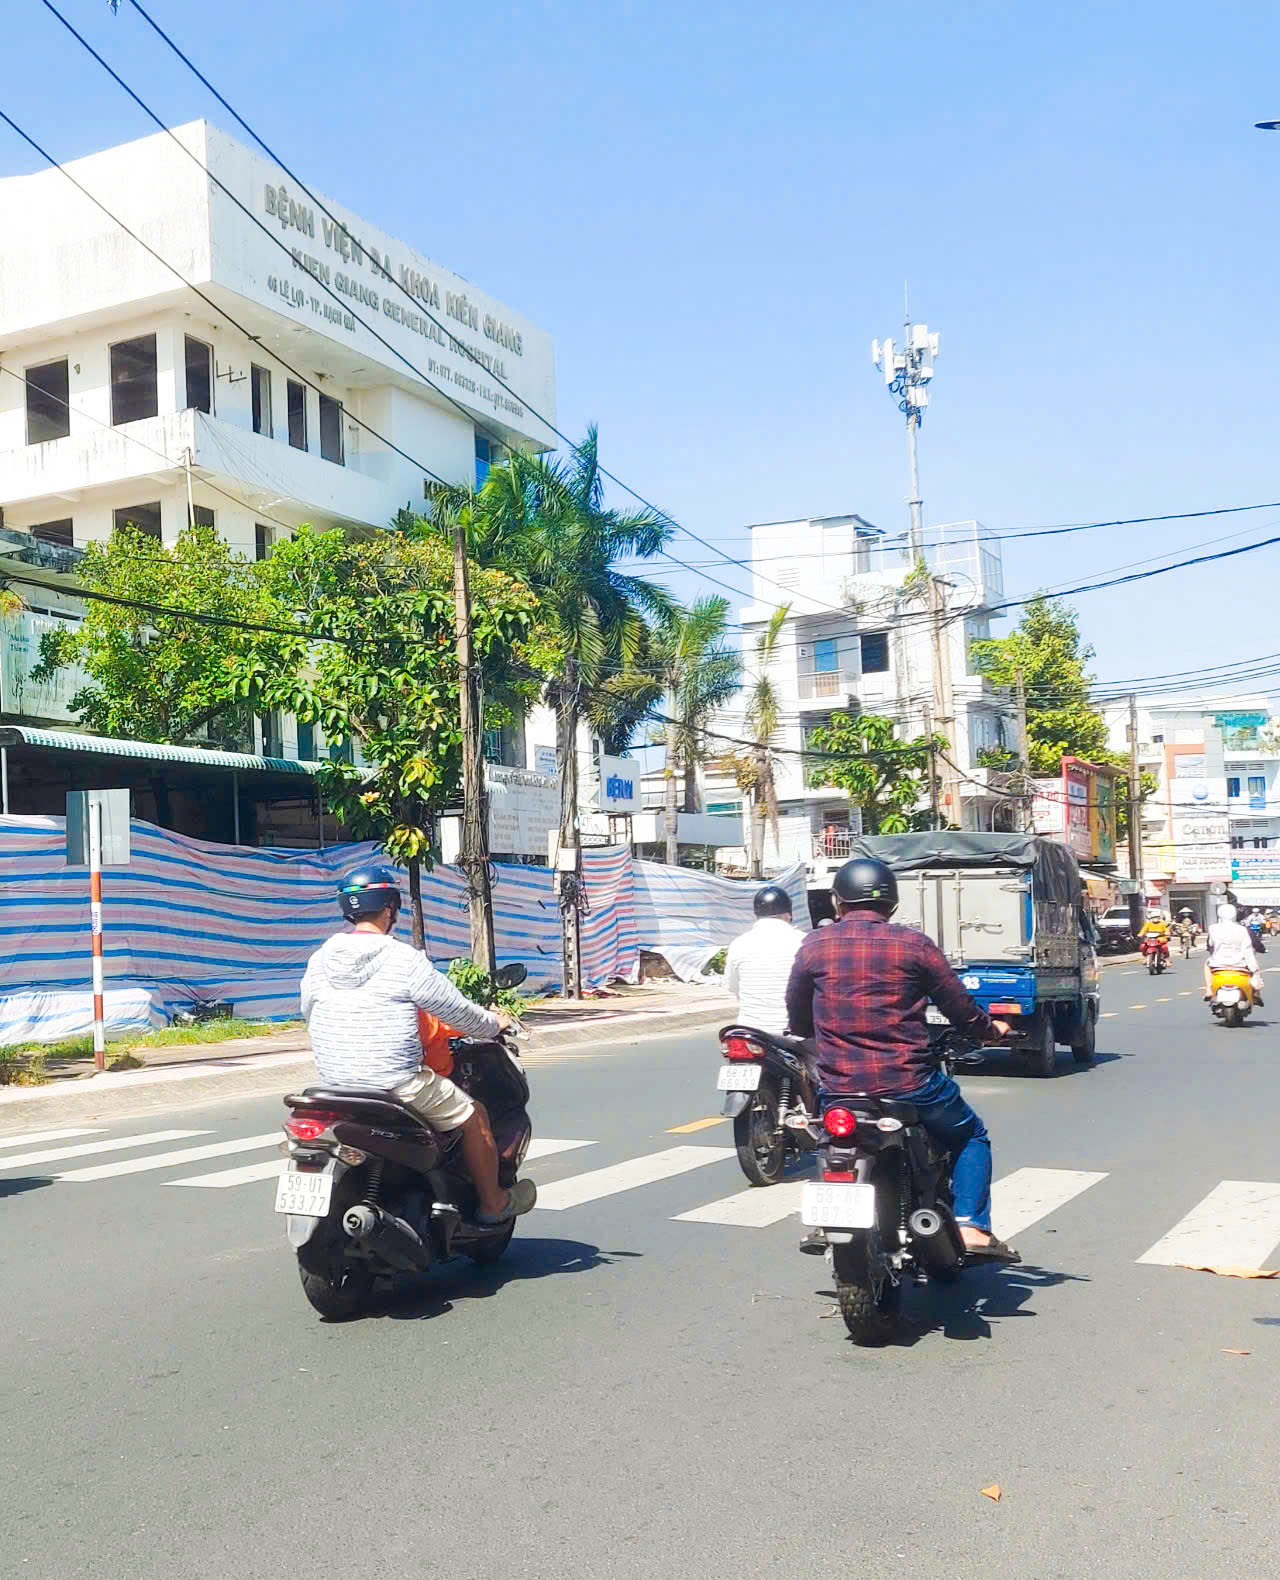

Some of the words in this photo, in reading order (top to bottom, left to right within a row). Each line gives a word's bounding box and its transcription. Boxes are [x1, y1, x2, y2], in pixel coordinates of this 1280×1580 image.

[264, 184, 315, 239] BỆNH
[322, 217, 363, 266] VIỆN
[400, 263, 440, 310] KHOA
[483, 312, 523, 357] GIANG
[335, 271, 379, 312] GIANG
[382, 298, 446, 348] GENERAL
[449, 335, 508, 380] HOSPITAL
[279, 1193, 326, 1212] 533.77
[287, 1175, 323, 1193] 59-U1
